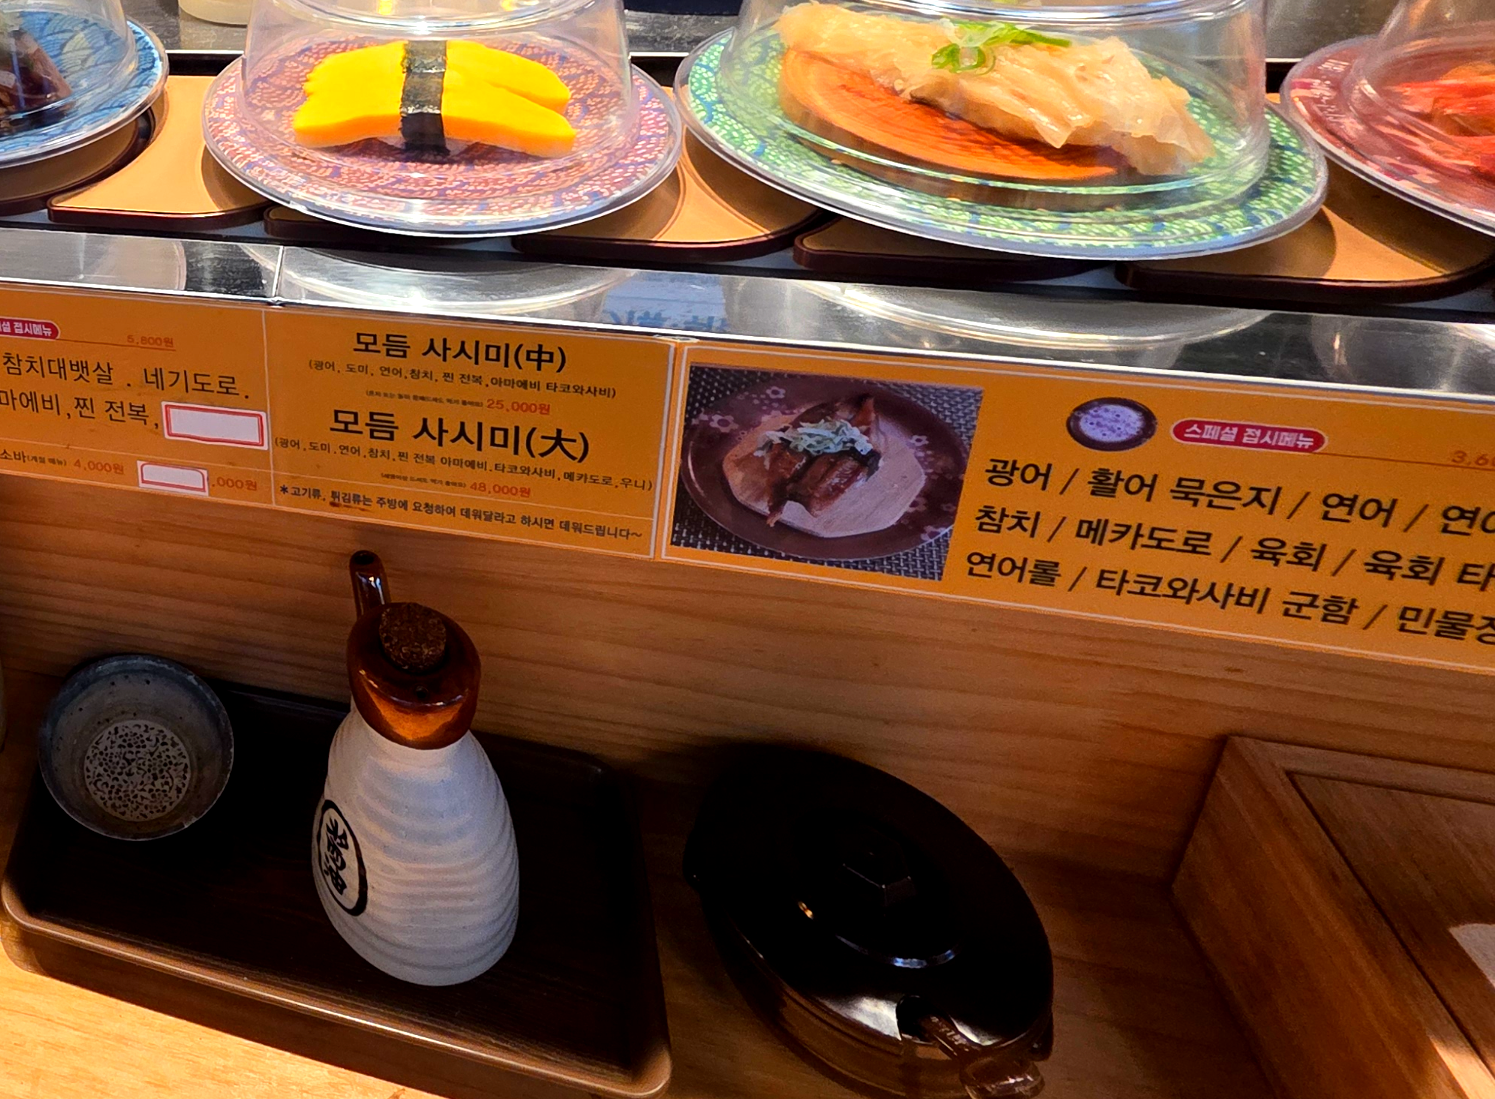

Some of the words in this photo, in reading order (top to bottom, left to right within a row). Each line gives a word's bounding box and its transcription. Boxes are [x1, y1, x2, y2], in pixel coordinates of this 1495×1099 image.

[3, 352, 113, 386] 참치대뱃살
[353, 332, 410, 359] 모듬
[422, 337, 566, 373] 사시미(中)
[329, 409, 399, 442] 모듬
[412, 417, 590, 463] 사시미(大)
[1184, 424, 1238, 442] 스페셜
[1242, 428, 1315, 448] 접시메뉴
[376, 497, 409, 511] 주방에
[412, 501, 456, 517] 요청하여
[459, 507, 516, 524] 데워달라고
[521, 515, 555, 531] 하시면
[985, 458, 1053, 492] 광어
[1087, 467, 1159, 502] 활어
[1169, 476, 1283, 515] 묵은지
[1321, 492, 1399, 528] 연어
[975, 505, 1041, 538] 참치
[1075, 518, 1213, 556] 메카도로
[1250, 537, 1328, 572] 육회
[1364, 550, 1446, 586] 육회
[966, 552, 1062, 587] 연어롤
[1096, 569, 1271, 615] 타코와사비
[1281, 590, 1360, 625] 군함
